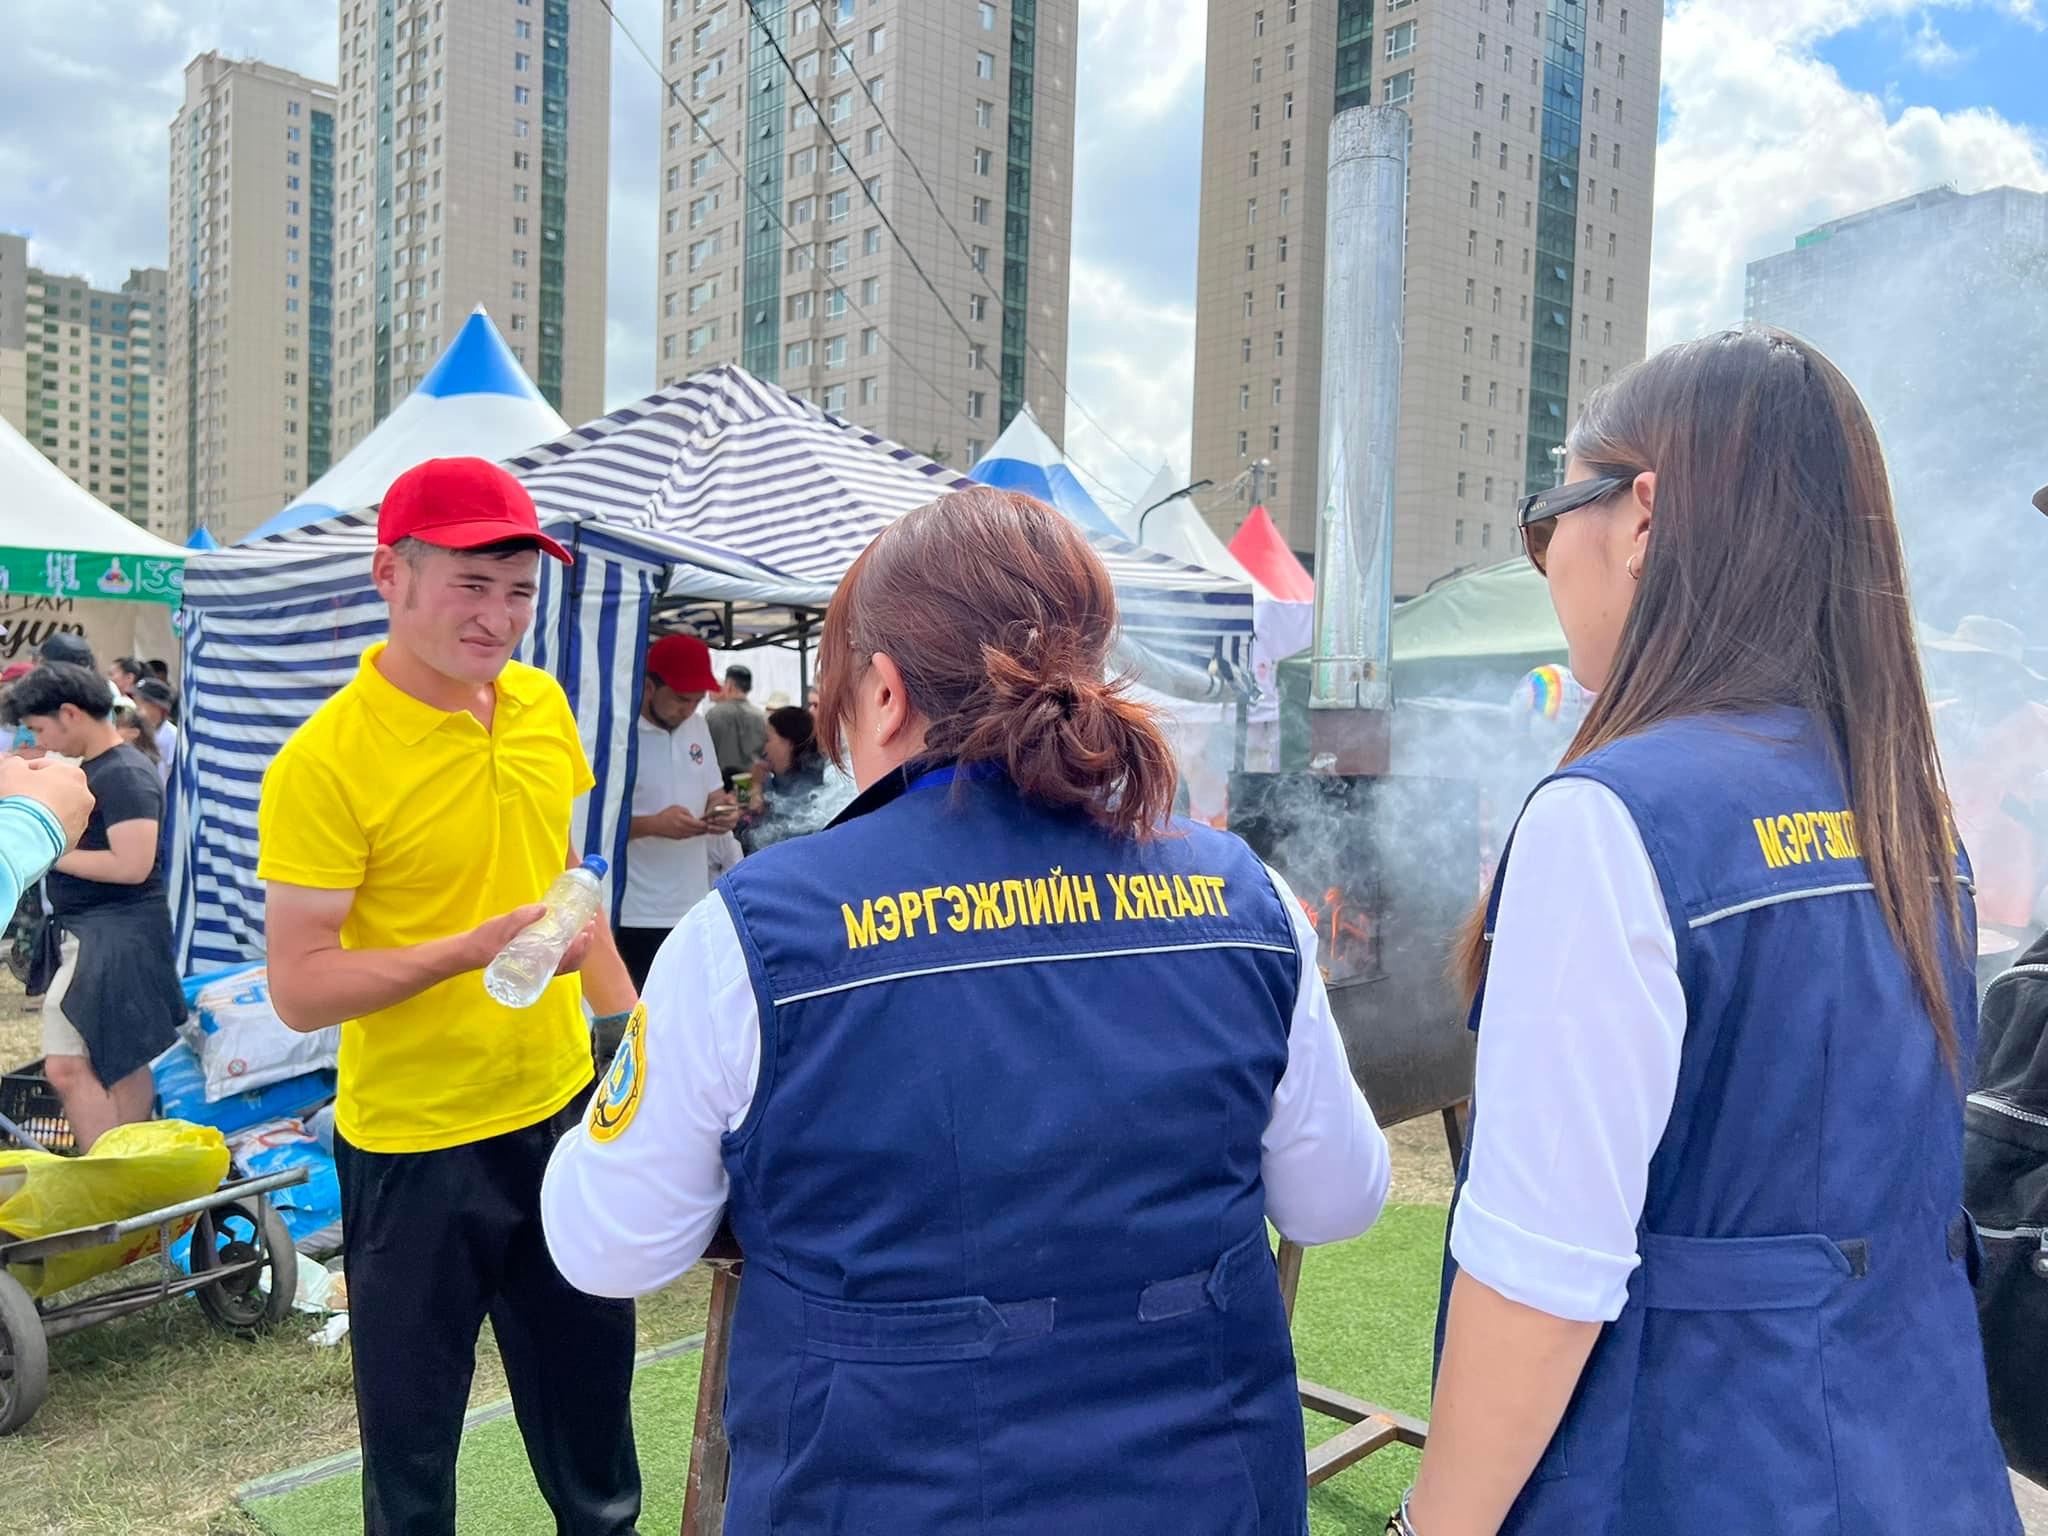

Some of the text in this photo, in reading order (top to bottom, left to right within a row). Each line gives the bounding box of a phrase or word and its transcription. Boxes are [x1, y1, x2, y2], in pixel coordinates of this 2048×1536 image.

[1753, 810, 1861, 869] МЭРГЭЖЛ
[841, 865, 1230, 950] МЭРГЭЖЛИЙН ХЯНАЛТ
